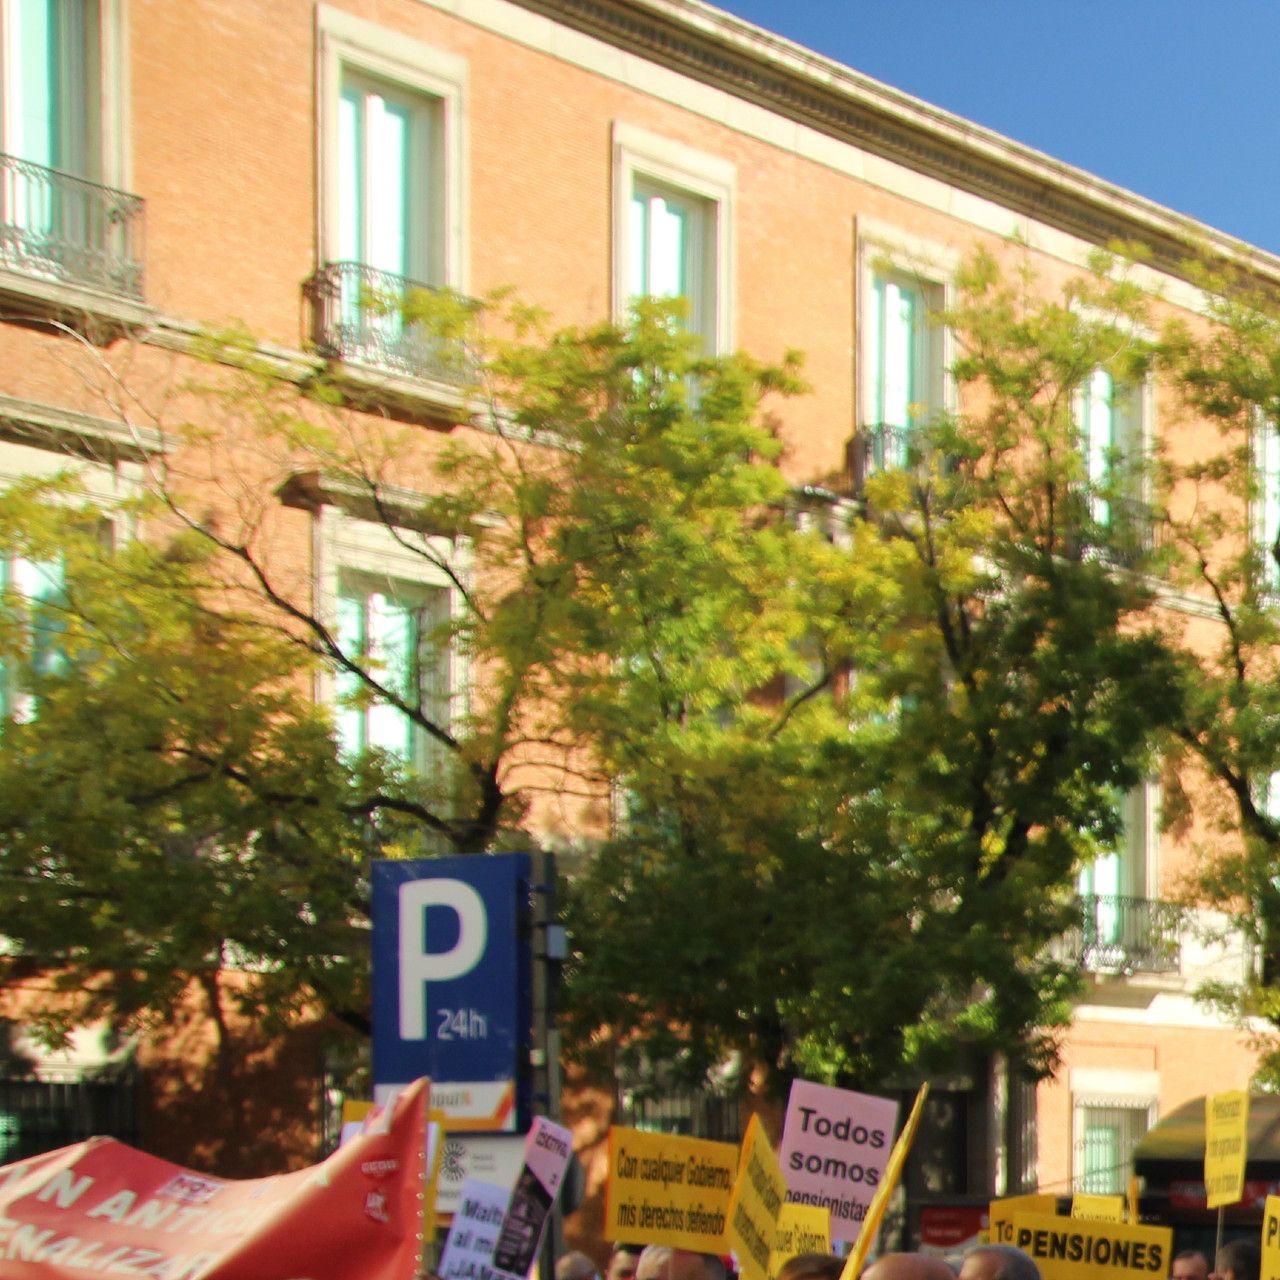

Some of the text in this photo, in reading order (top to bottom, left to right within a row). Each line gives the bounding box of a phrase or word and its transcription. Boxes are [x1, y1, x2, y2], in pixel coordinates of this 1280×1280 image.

[398, 877, 489, 1042] P
[437, 1008, 488, 1040] 24h
[798, 1106, 885, 1149] Todos
[789, 1149, 880, 1187] somos
[1017, 1228, 1163, 1272] PENSIONES
